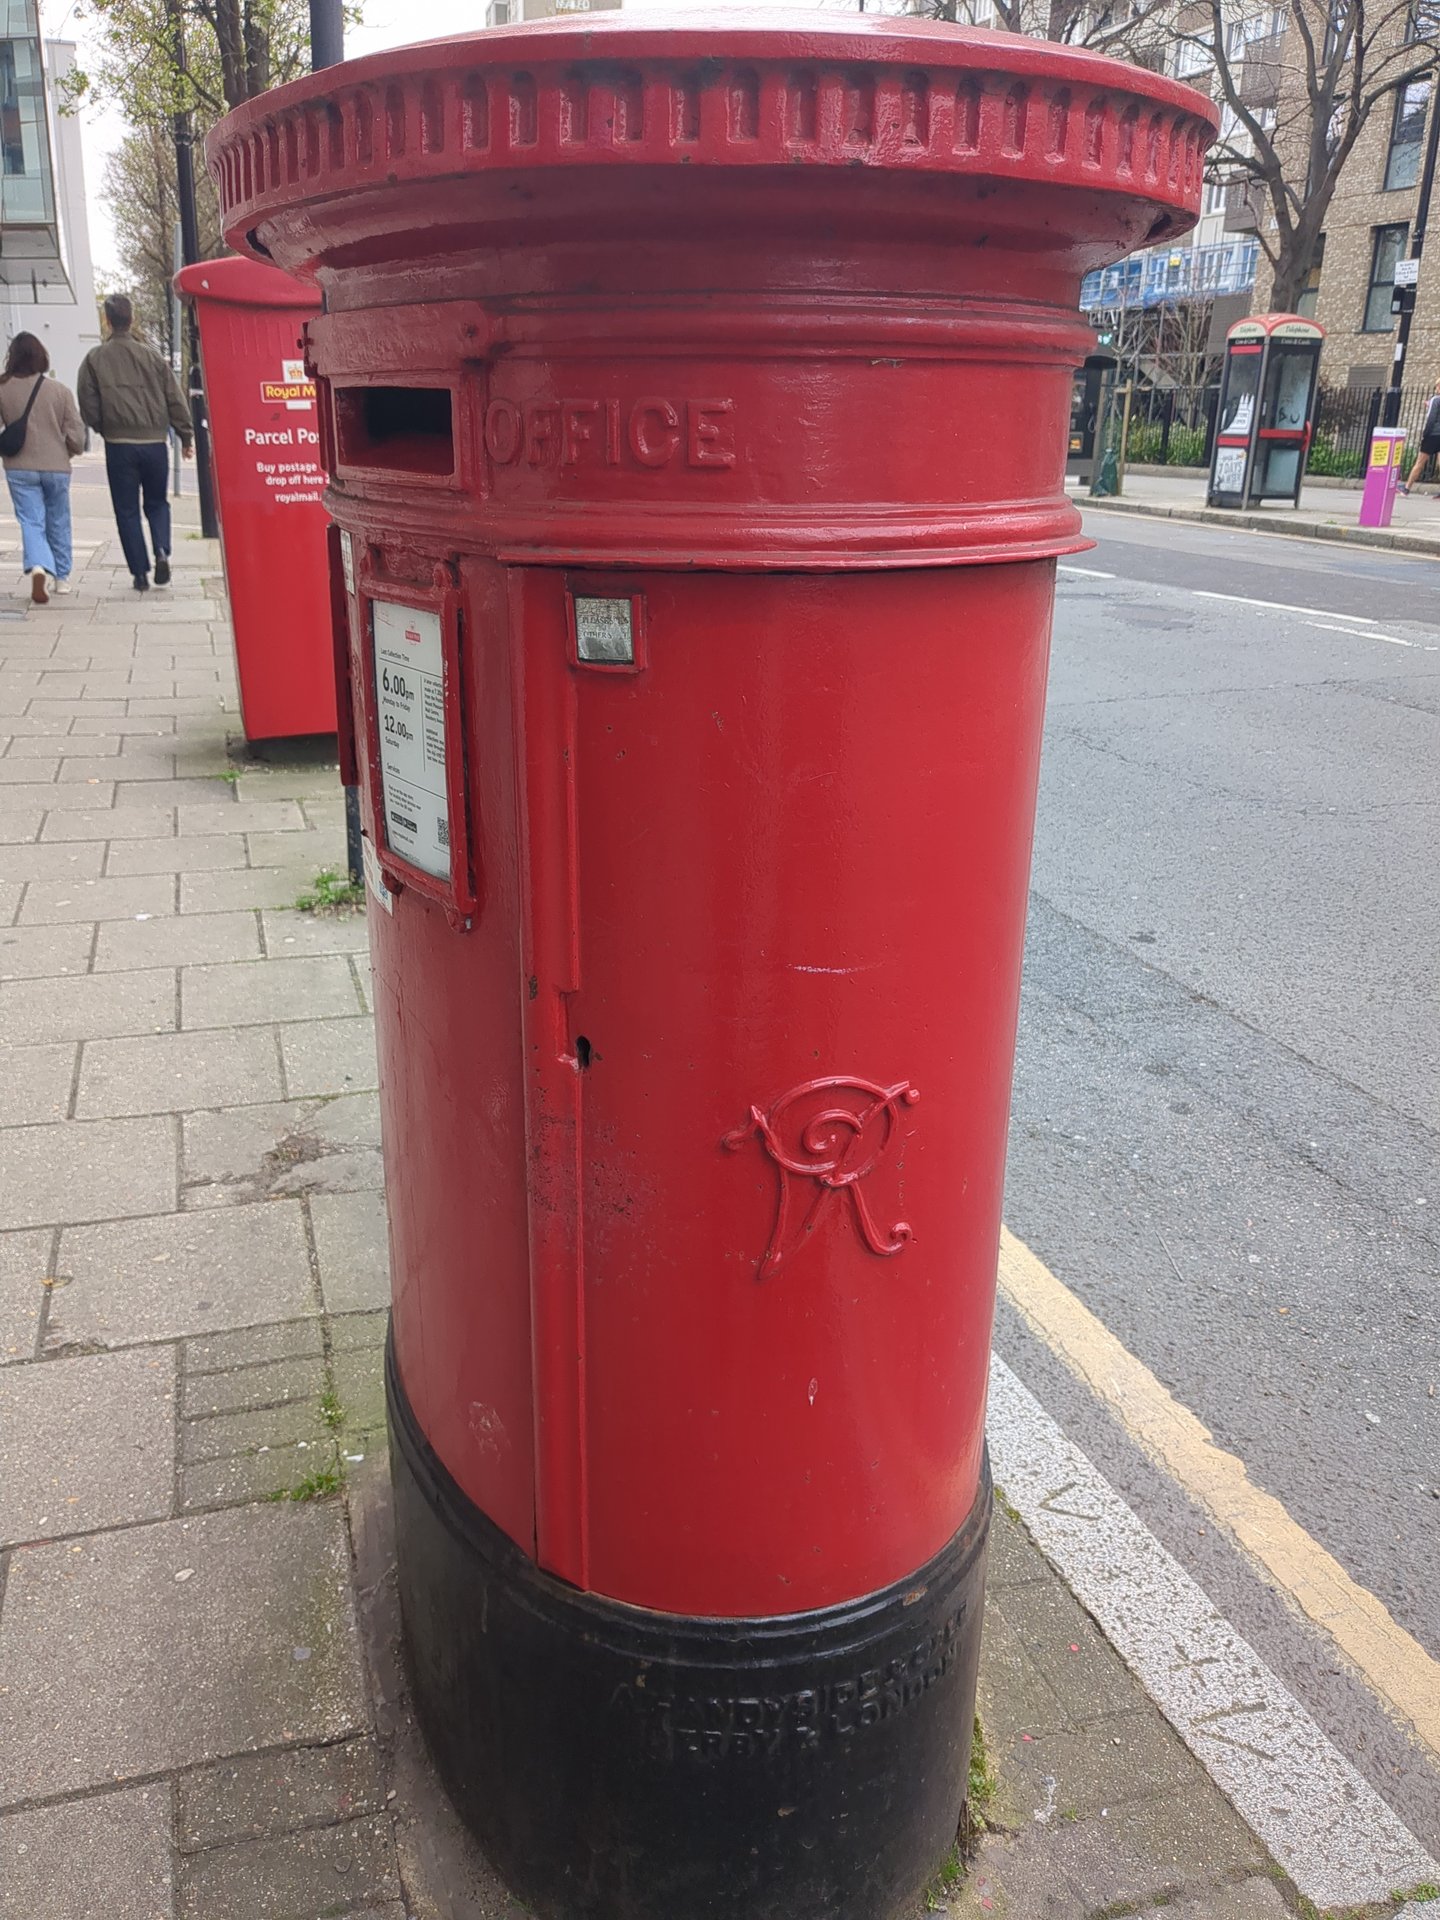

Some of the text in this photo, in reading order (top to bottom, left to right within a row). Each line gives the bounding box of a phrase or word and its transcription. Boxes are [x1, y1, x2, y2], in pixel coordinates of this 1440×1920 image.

[266, 385, 300, 399] Royal
[245, 428, 293, 445] Parcel
[484, 397, 737, 469] OFFICE
[256, 462, 317, 475] Buy postage
[265, 475, 287, 487] drop
[288, 475, 301, 485] off
[302, 475, 324, 485] here
[383, 667, 415, 701] 6.00pm
[384, 713, 414, 741] 12.00pm
